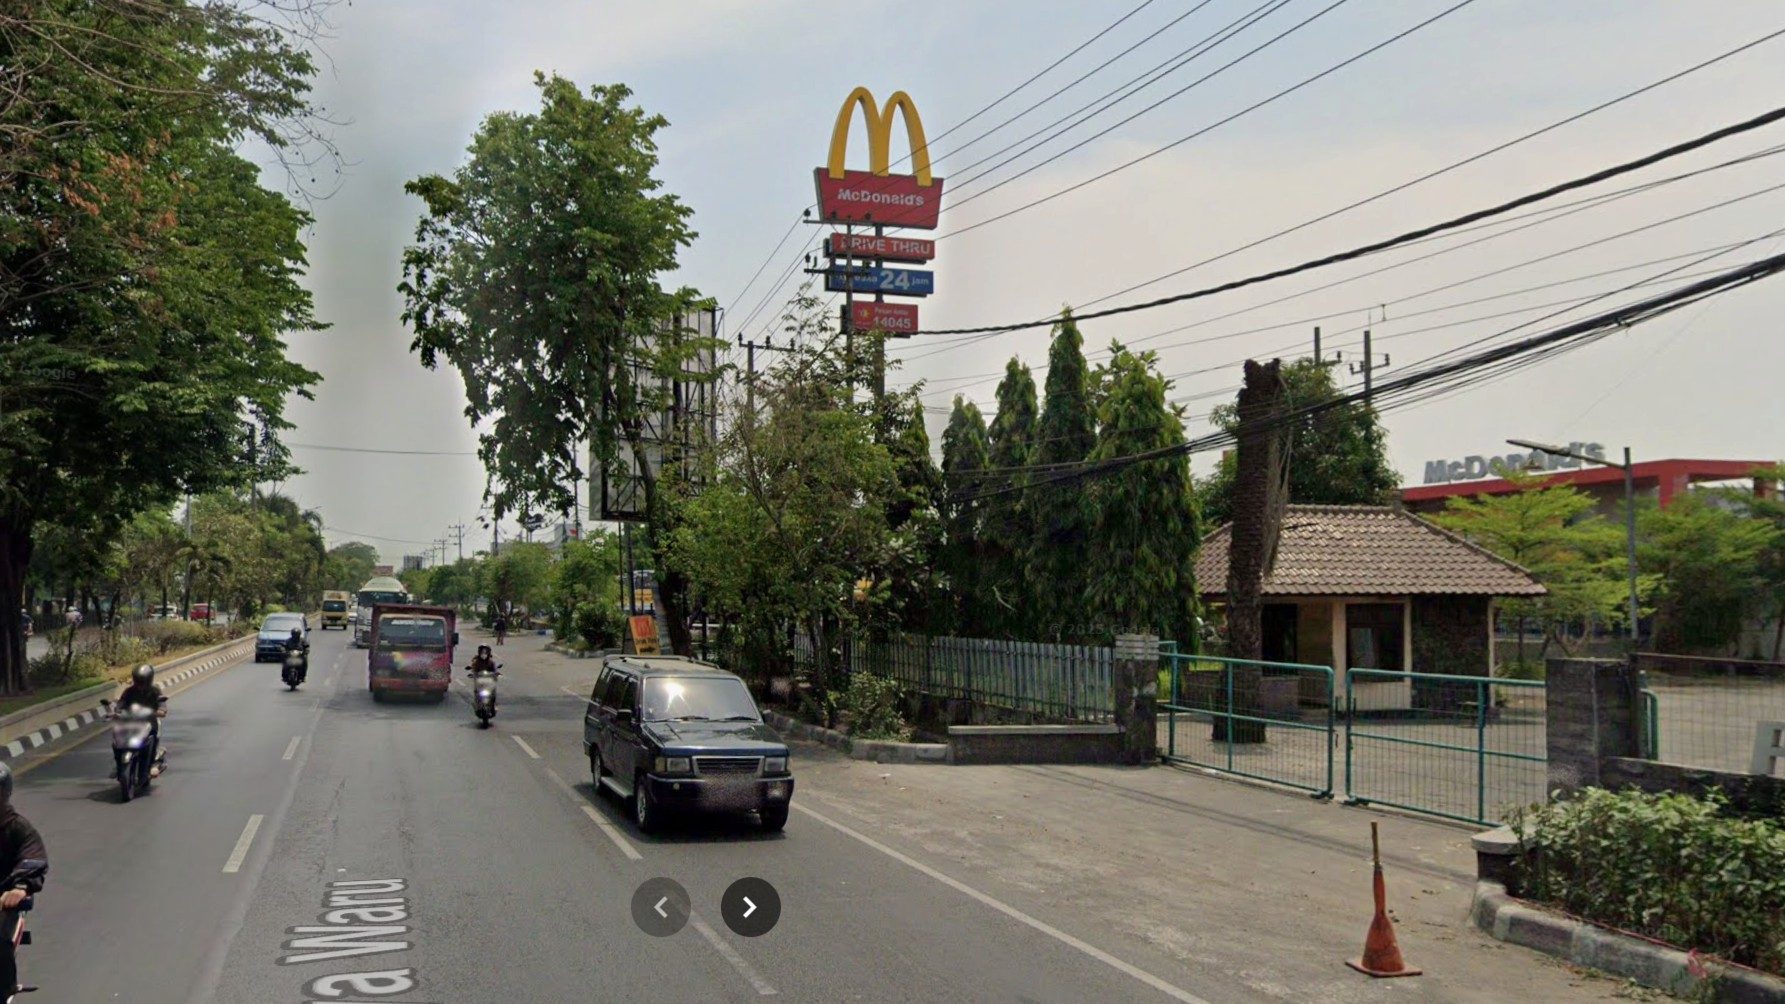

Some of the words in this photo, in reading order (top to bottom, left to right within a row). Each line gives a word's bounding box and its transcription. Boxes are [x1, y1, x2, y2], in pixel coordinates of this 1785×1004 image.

[837, 188, 925, 207] McDonald's
[891, 240, 931, 255] THRU
[880, 269, 910, 291] 24
[872, 315, 912, 330] 14045
